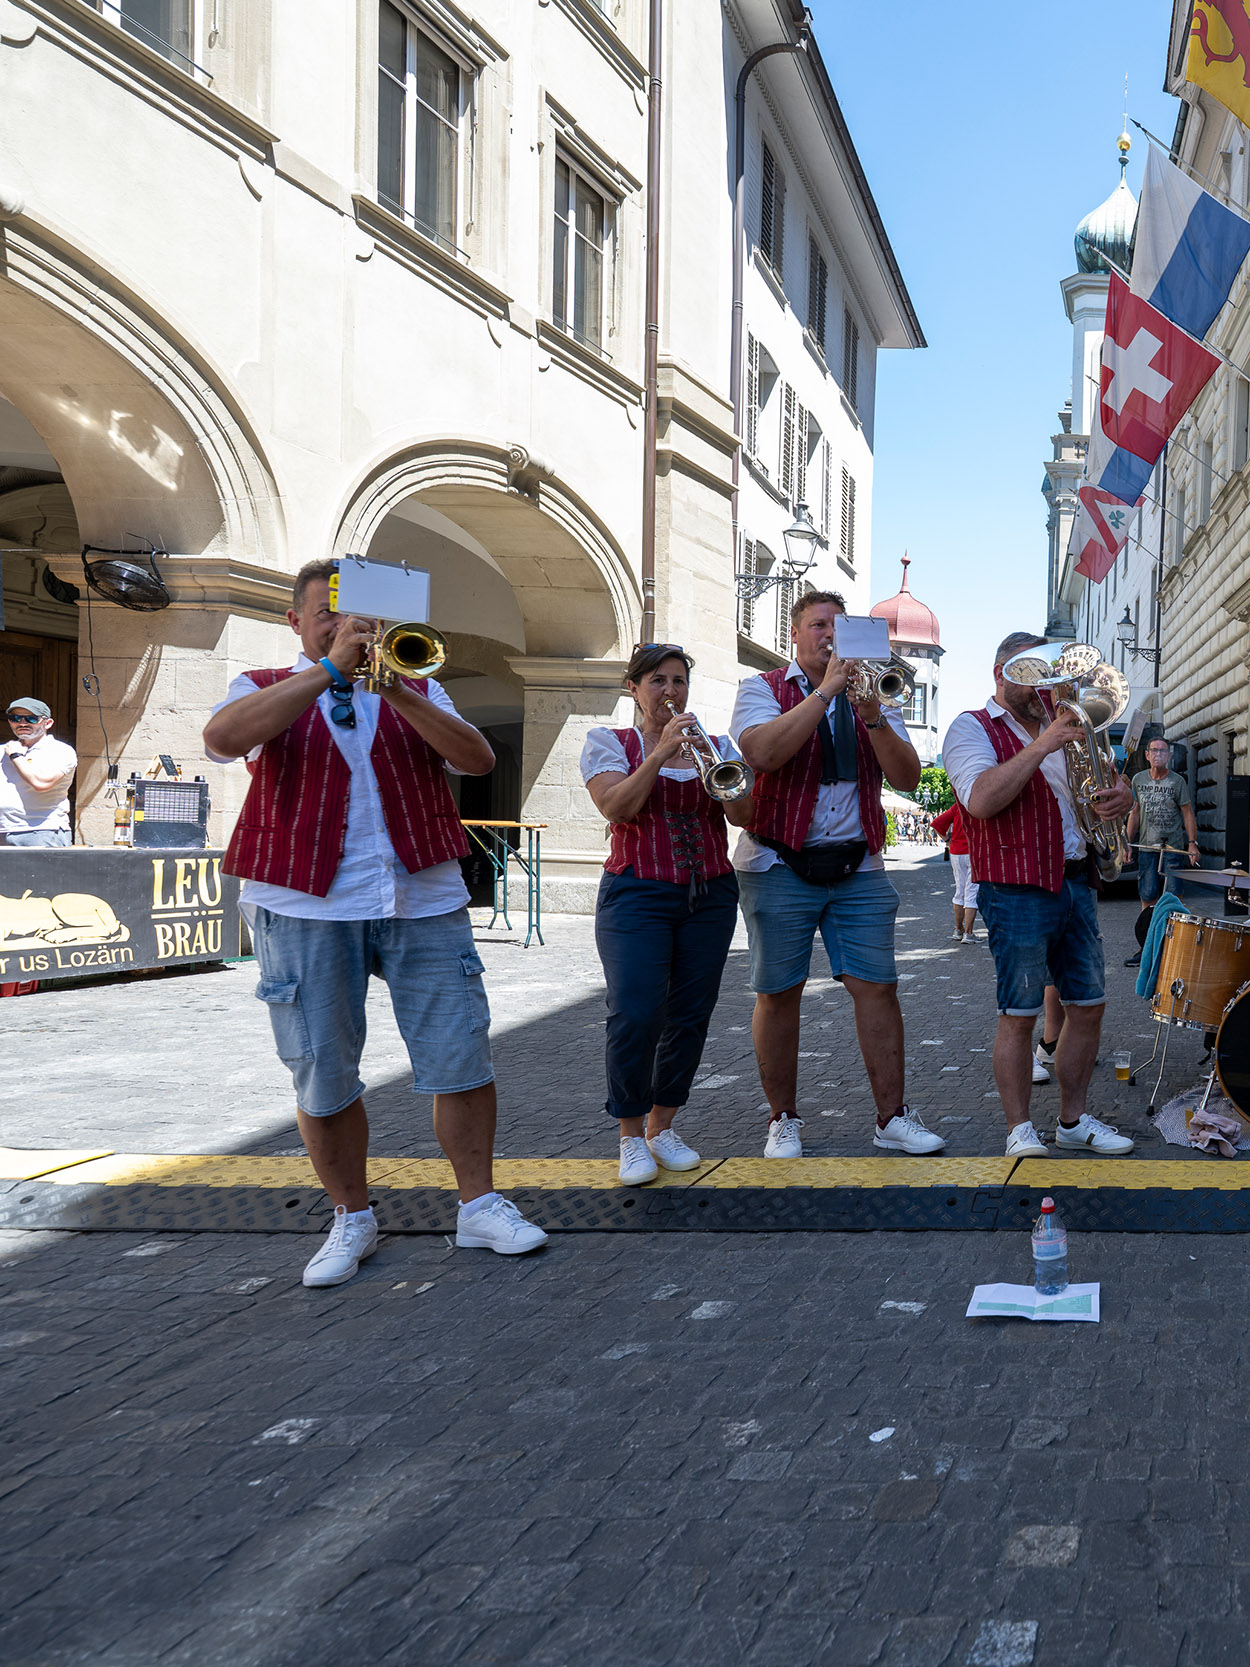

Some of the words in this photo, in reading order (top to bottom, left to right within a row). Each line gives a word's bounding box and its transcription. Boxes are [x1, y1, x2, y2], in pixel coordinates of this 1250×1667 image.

[1136, 784, 1153, 793] CAMP
[1154, 785, 1175, 795] DAVID
[151, 857, 223, 910] LEU
[19, 953, 49, 972] us
[54, 945, 134, 969] Lozärn
